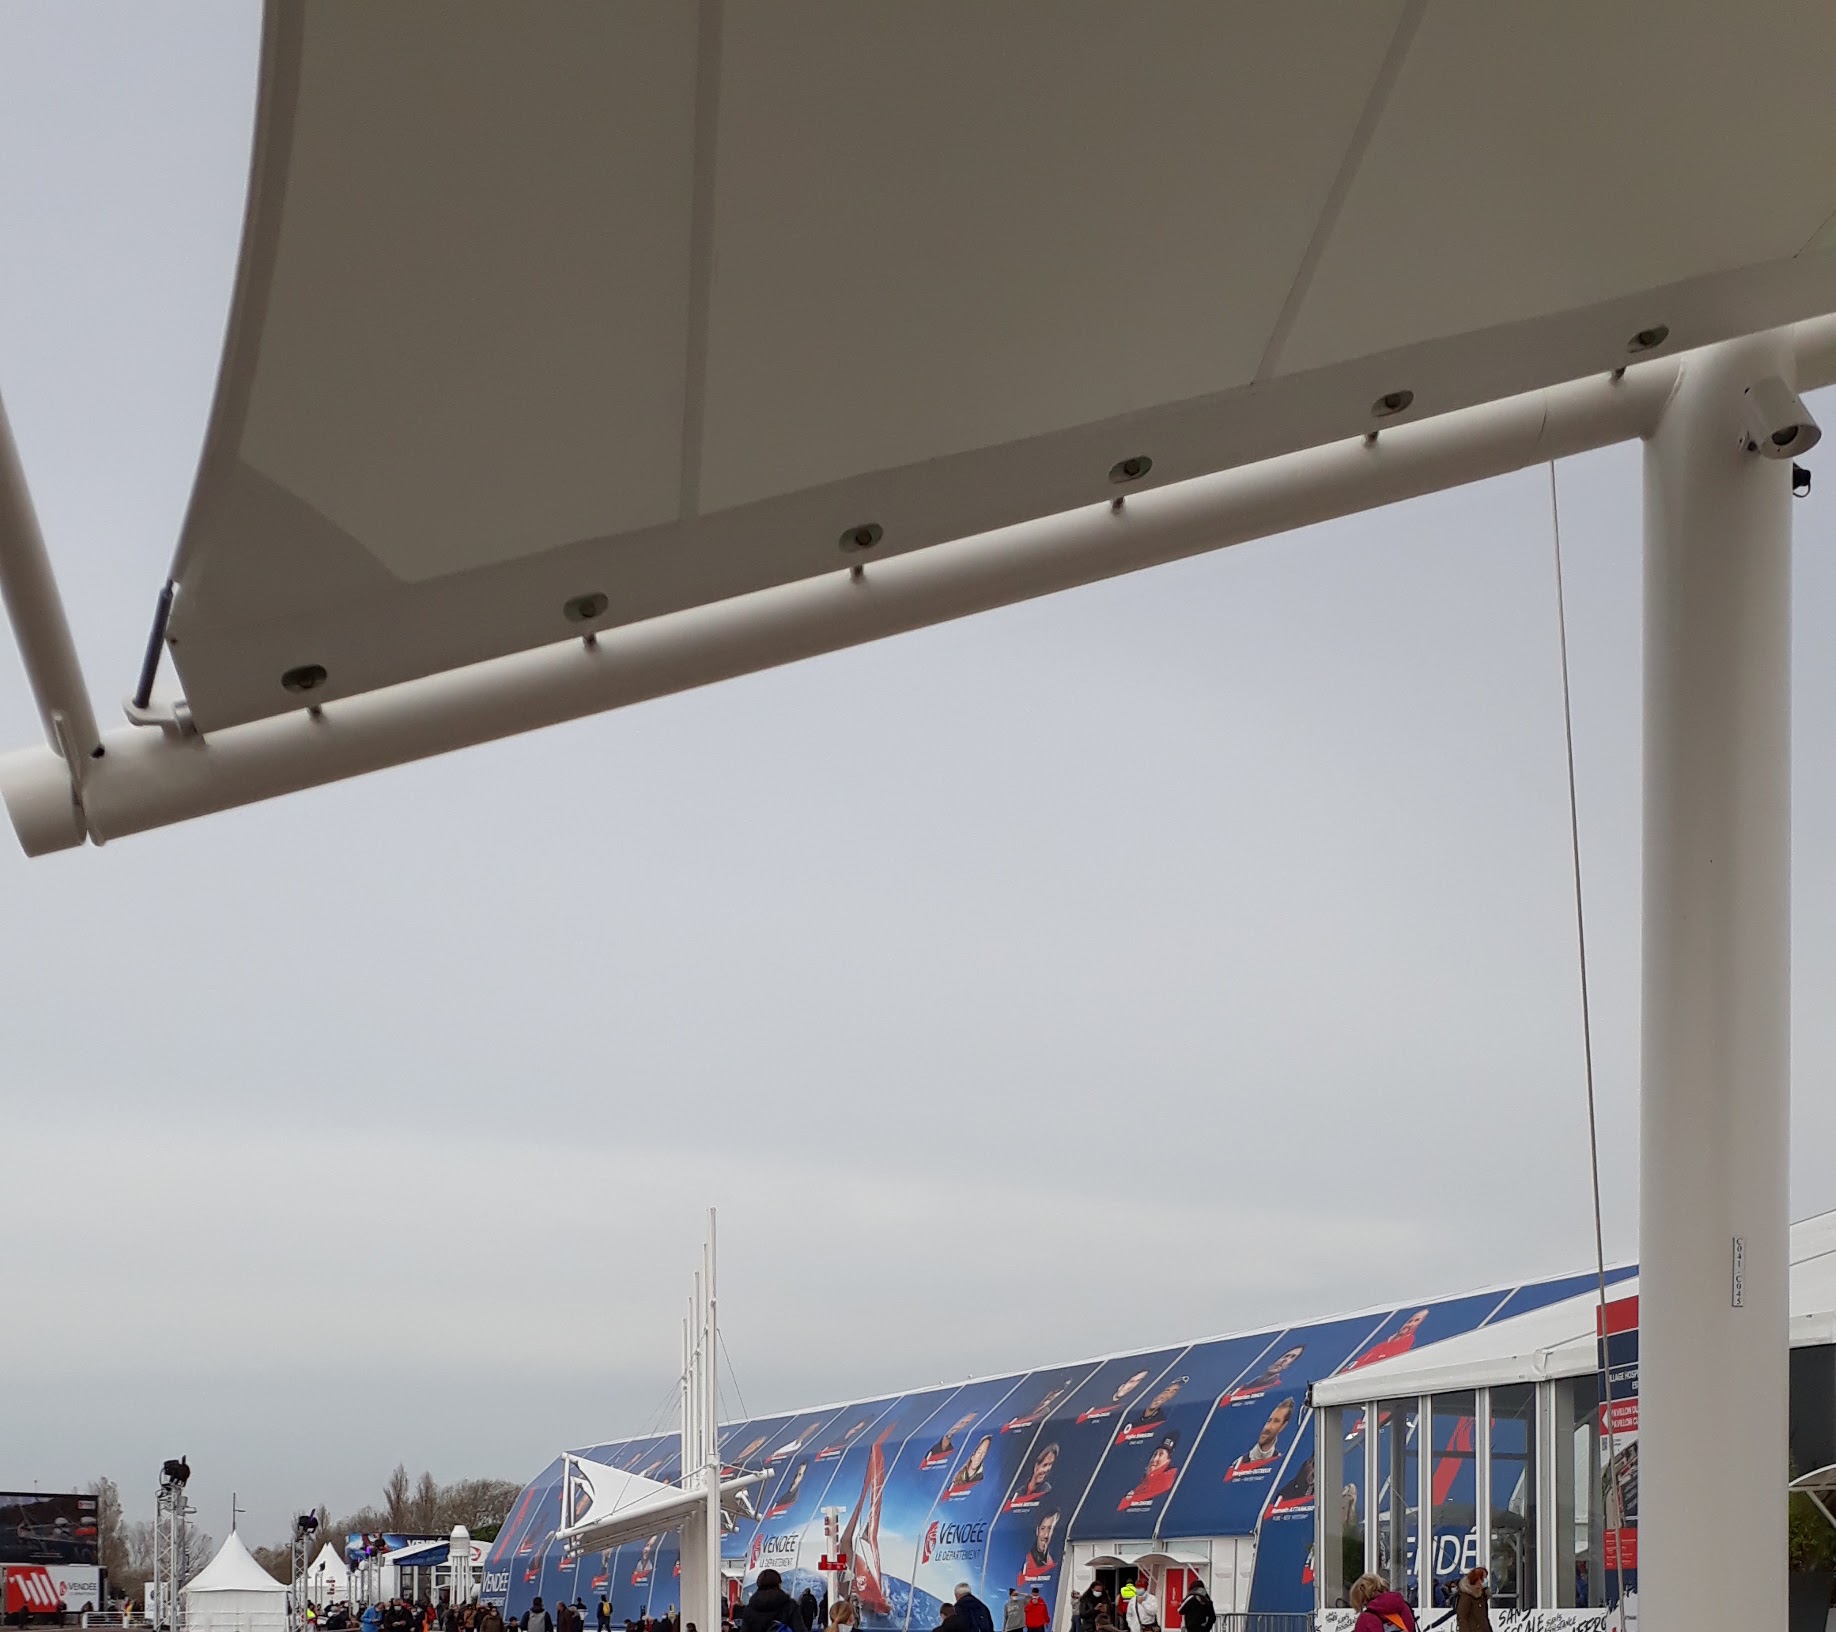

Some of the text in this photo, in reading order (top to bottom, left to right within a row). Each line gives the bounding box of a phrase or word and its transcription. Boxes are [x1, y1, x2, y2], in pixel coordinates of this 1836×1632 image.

[1609, 1372, 1624, 1383] ILLAGE
[938, 1518, 988, 1545] VENDÉE
[761, 1531, 799, 1554] VENDÉE
[1498, 1607, 1532, 1627] SANS
